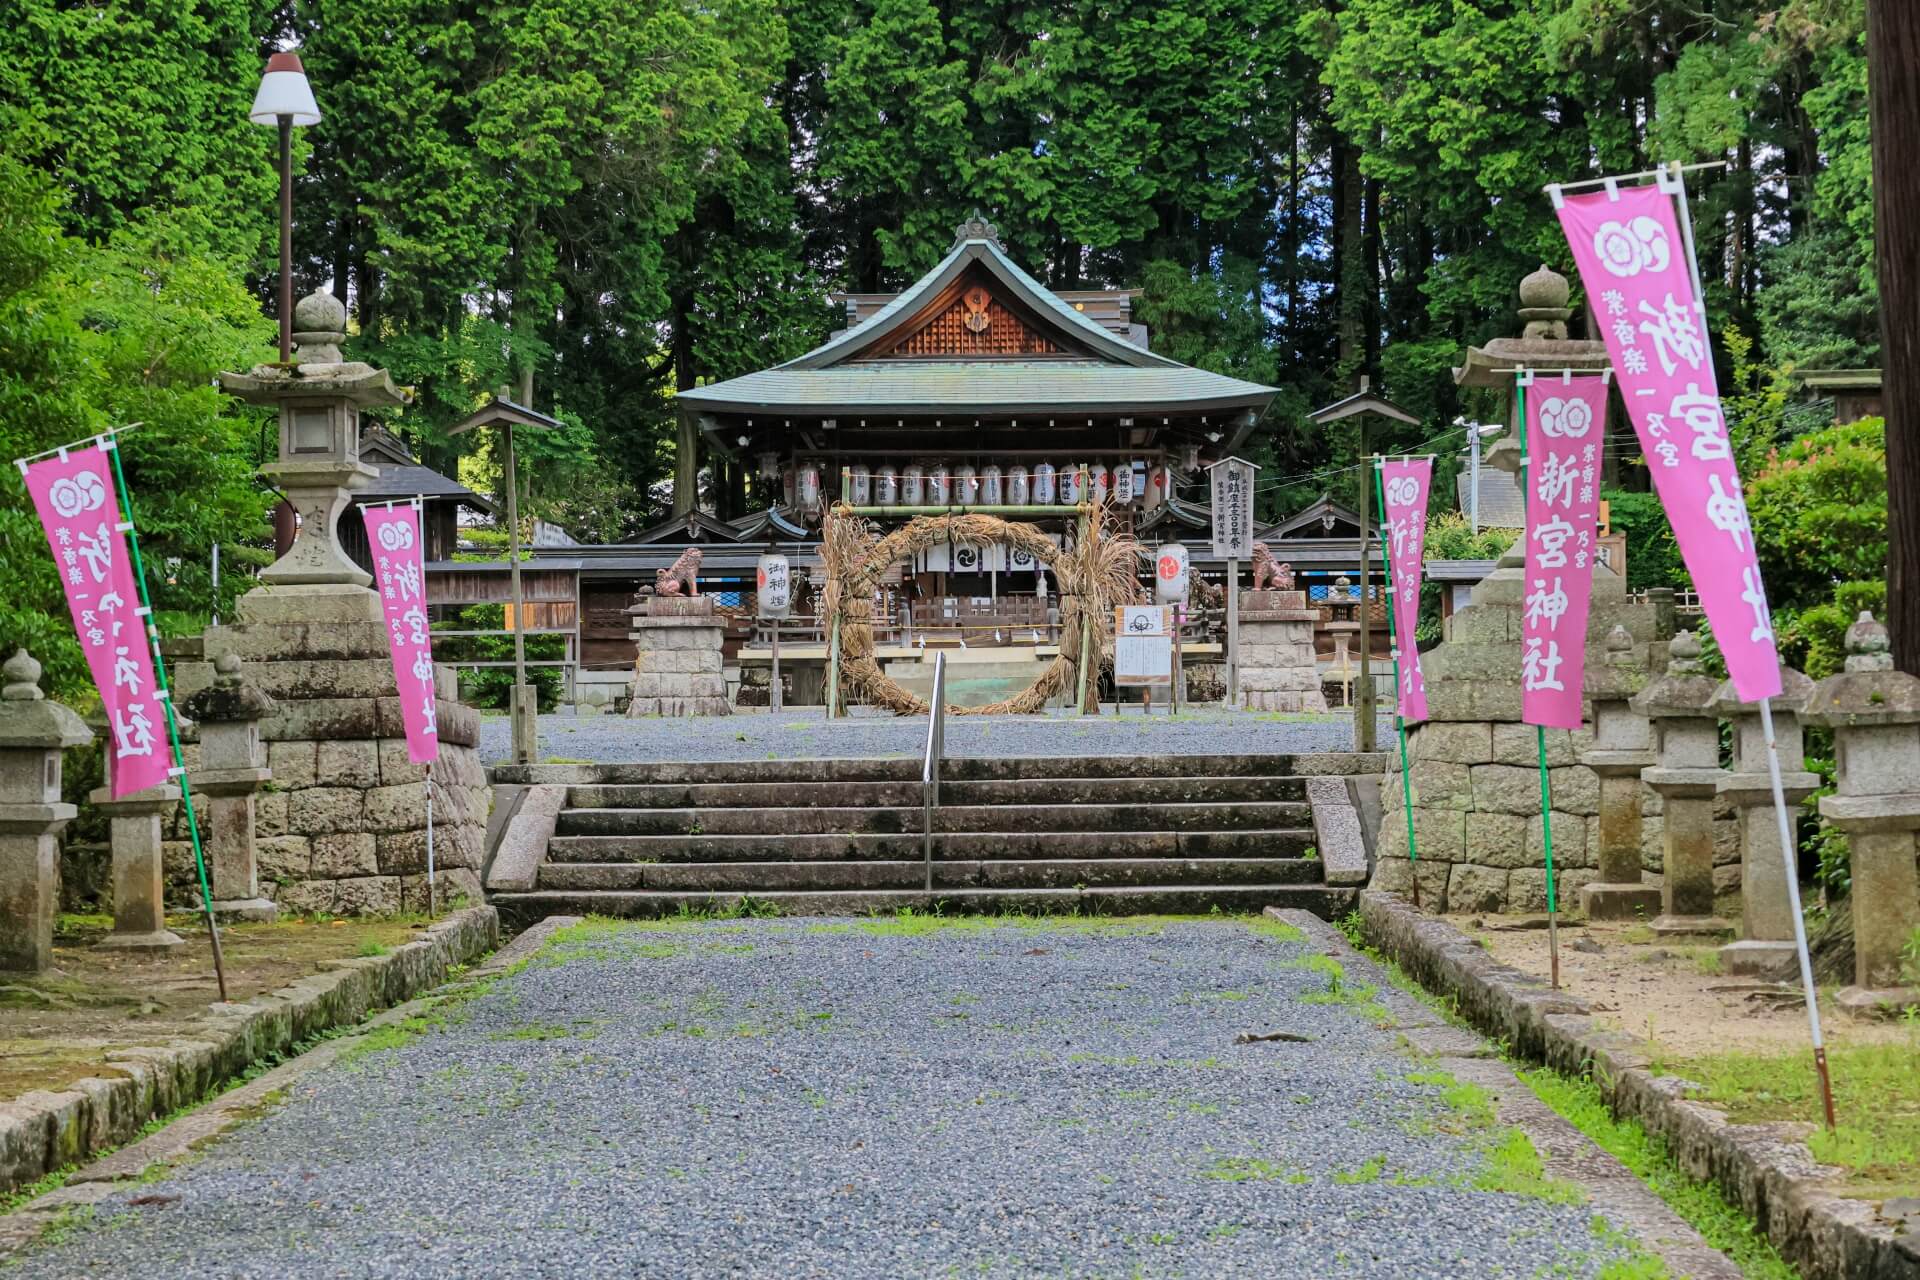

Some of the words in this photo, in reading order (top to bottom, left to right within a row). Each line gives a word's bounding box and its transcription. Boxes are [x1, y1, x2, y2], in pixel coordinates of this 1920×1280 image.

[1574, 443, 1595, 569] 紫香楽一乃宮
[768, 562, 786, 607] 御神燈
[1522, 450, 1580, 692] 新宮神社
